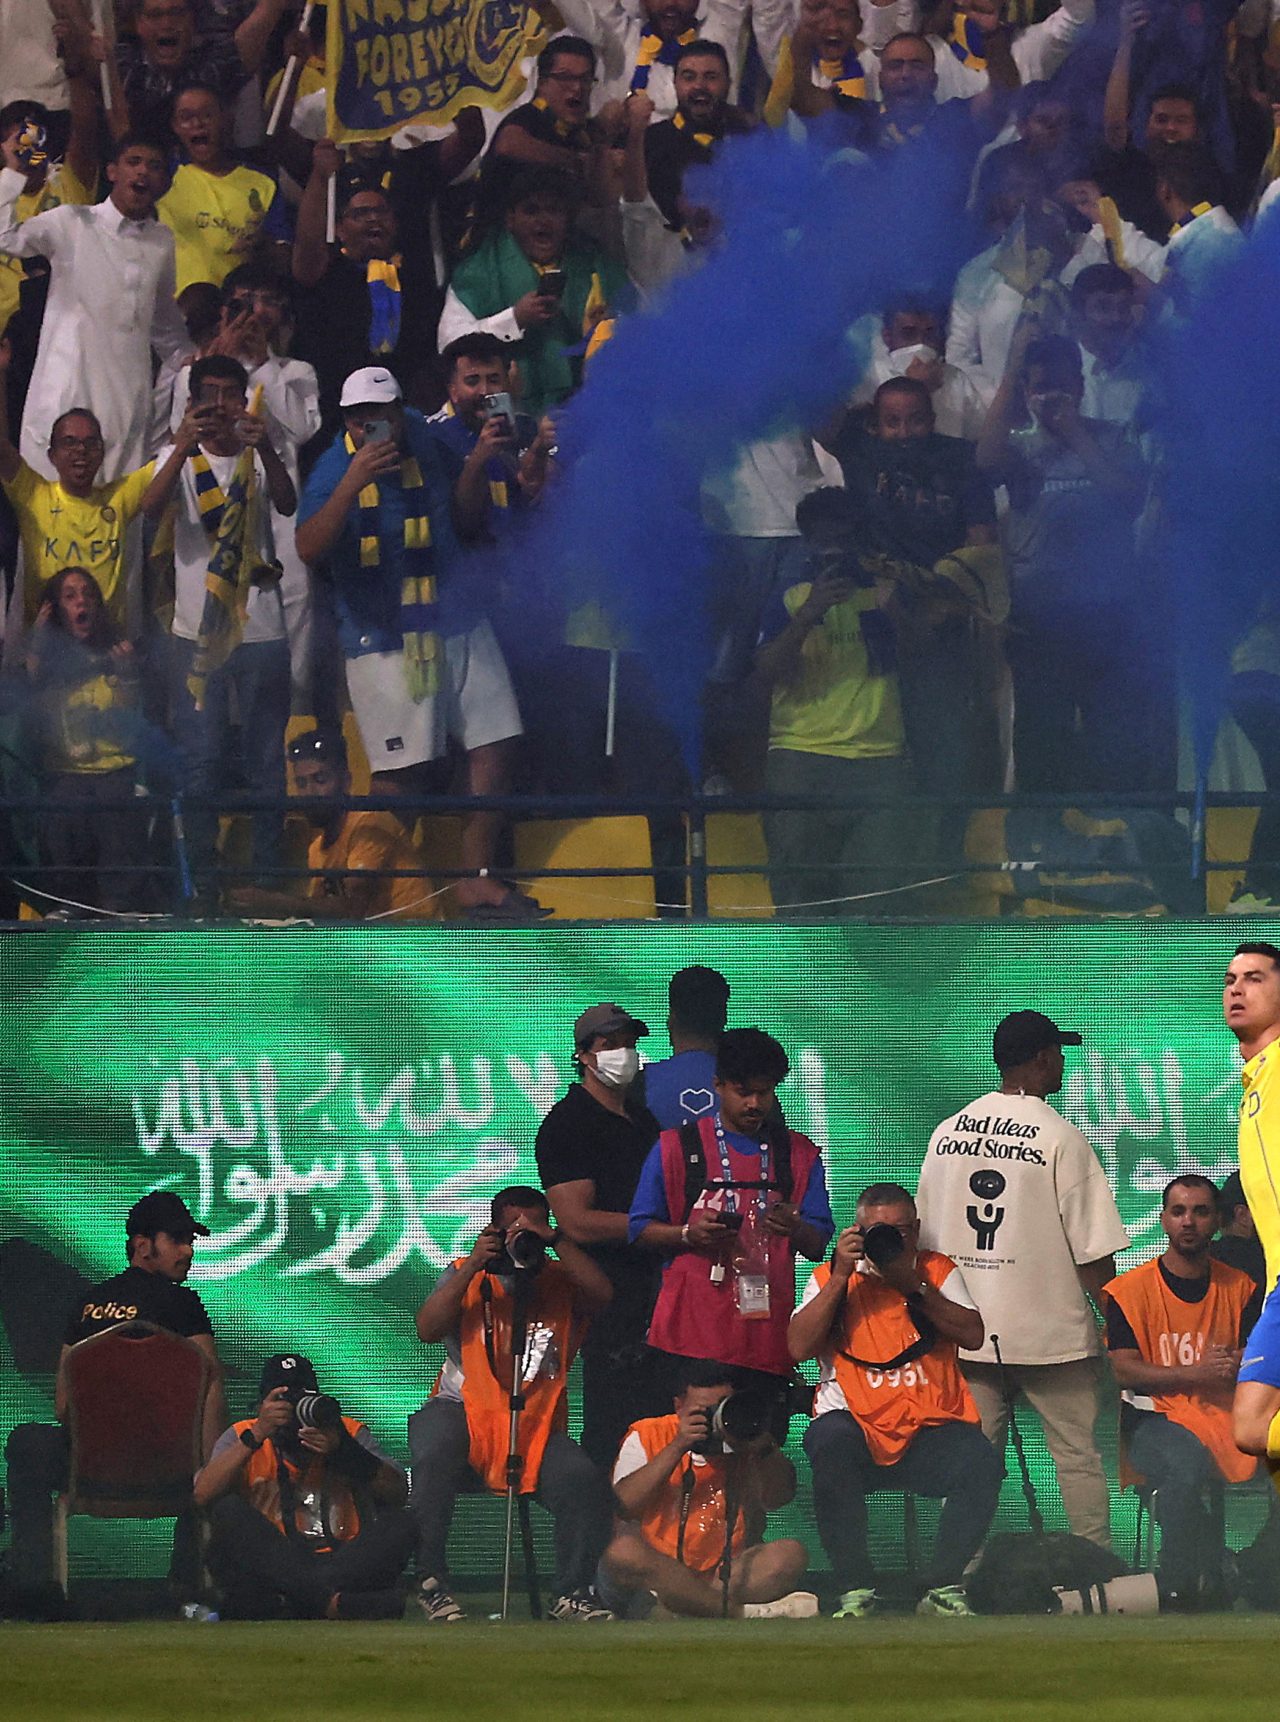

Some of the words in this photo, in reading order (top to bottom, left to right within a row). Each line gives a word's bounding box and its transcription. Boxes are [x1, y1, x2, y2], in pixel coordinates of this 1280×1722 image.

[954, 1115, 991, 1134] Bad
[991, 1117, 1041, 1140] Ideas
[936, 1136, 983, 1157] Good
[983, 1137, 1047, 1167] Stories.
[81, 1301, 138, 1322] Police
